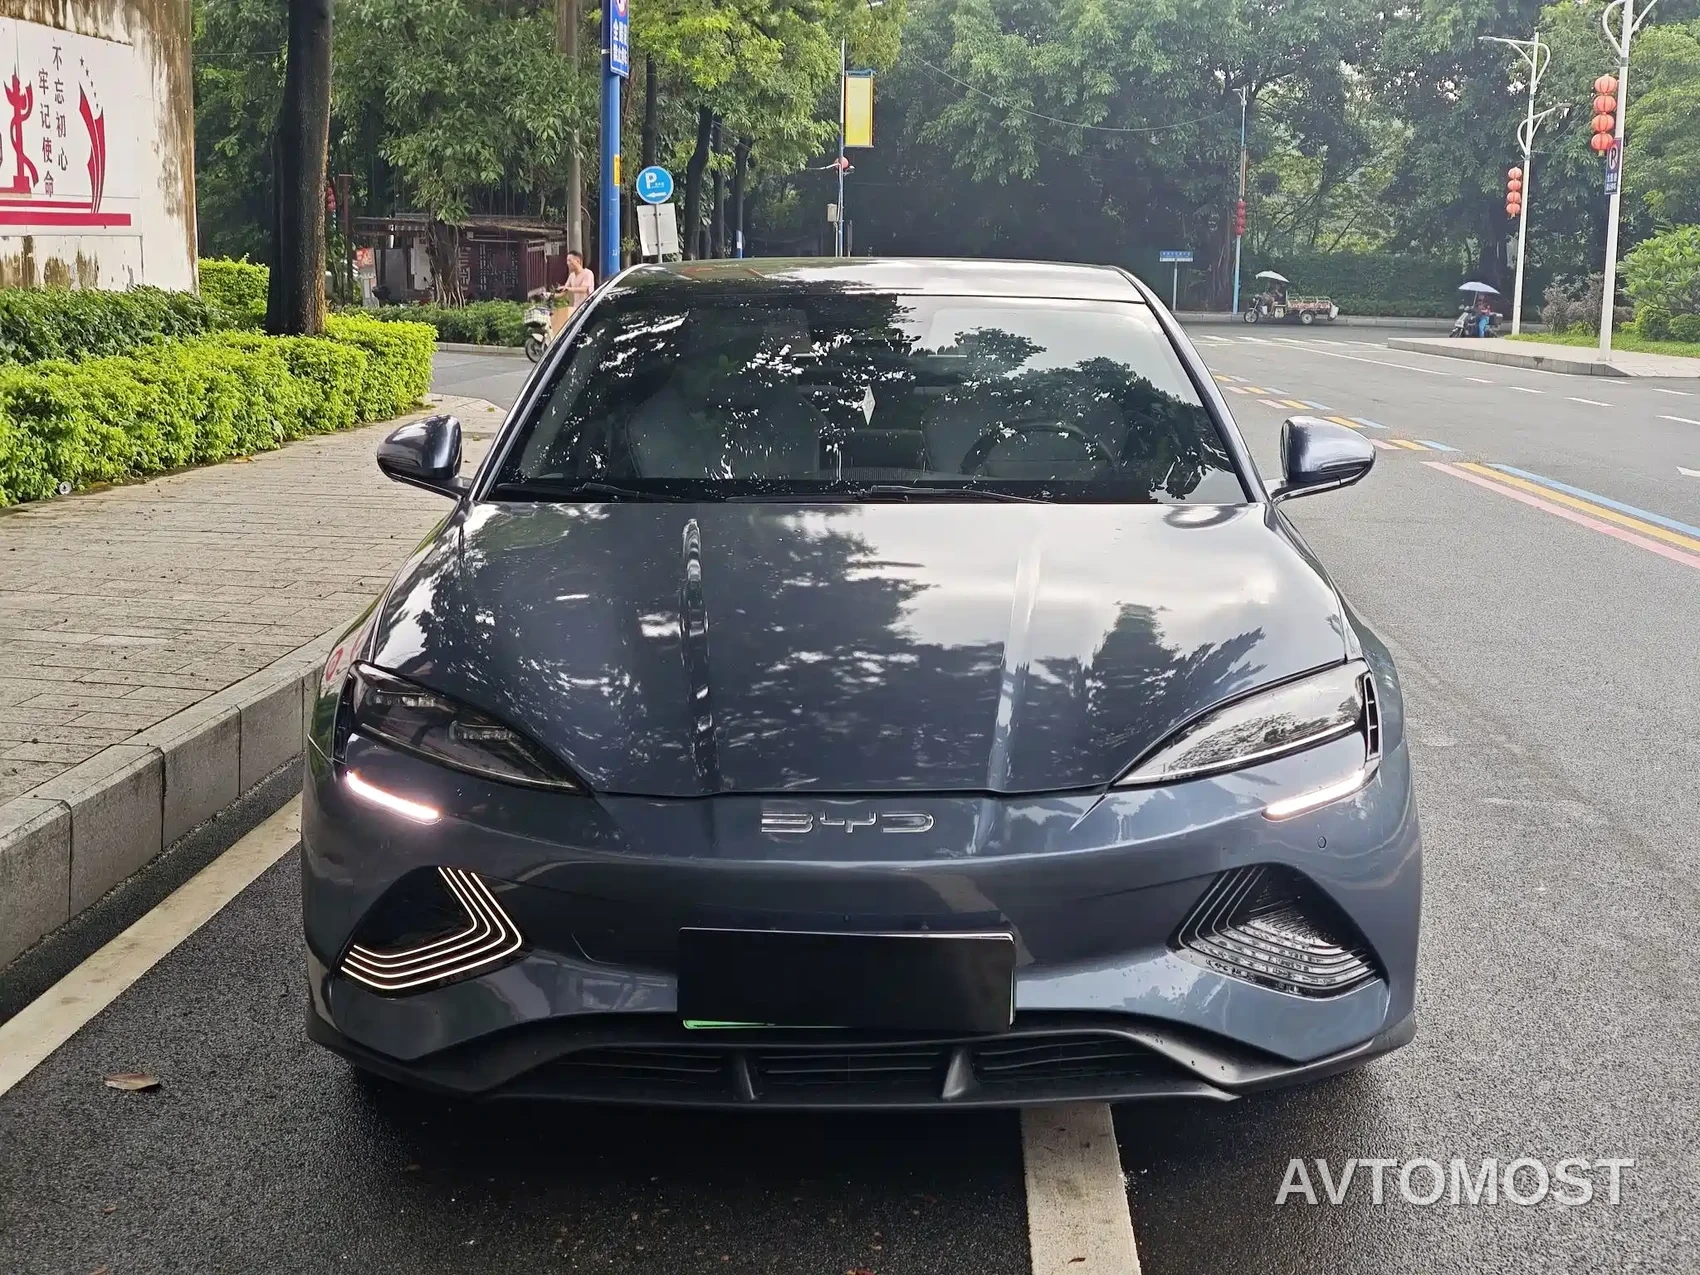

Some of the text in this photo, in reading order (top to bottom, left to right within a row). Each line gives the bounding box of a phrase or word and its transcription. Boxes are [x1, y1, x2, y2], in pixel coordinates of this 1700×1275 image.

[38, 68, 54, 198] 牢记使命
[52, 46, 68, 171] 不忘初心
[645, 172, 657, 189] P
[761, 810, 935, 833] BYD
